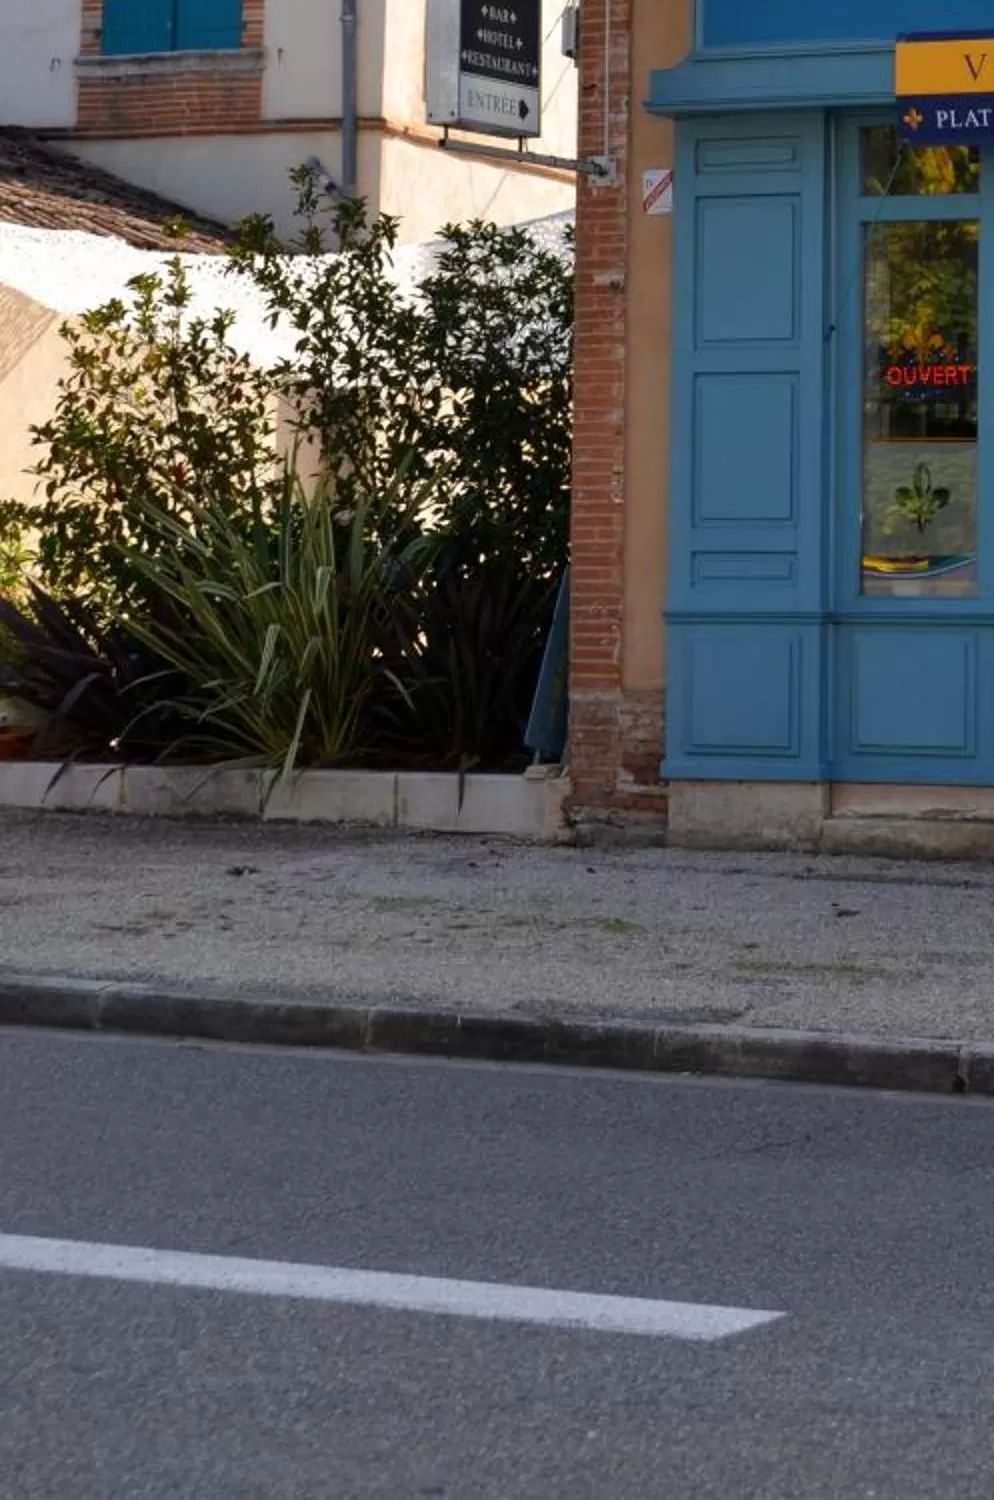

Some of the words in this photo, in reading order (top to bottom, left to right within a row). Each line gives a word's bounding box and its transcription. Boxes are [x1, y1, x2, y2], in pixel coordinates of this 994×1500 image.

[489, 5, 510, 23] BAR
[483, 29, 515, 49] HOTEL
[468, 50, 532, 76] RESTAURANT
[936, 108, 992, 129] PLAT
[886, 364, 971, 386] OUVERT
